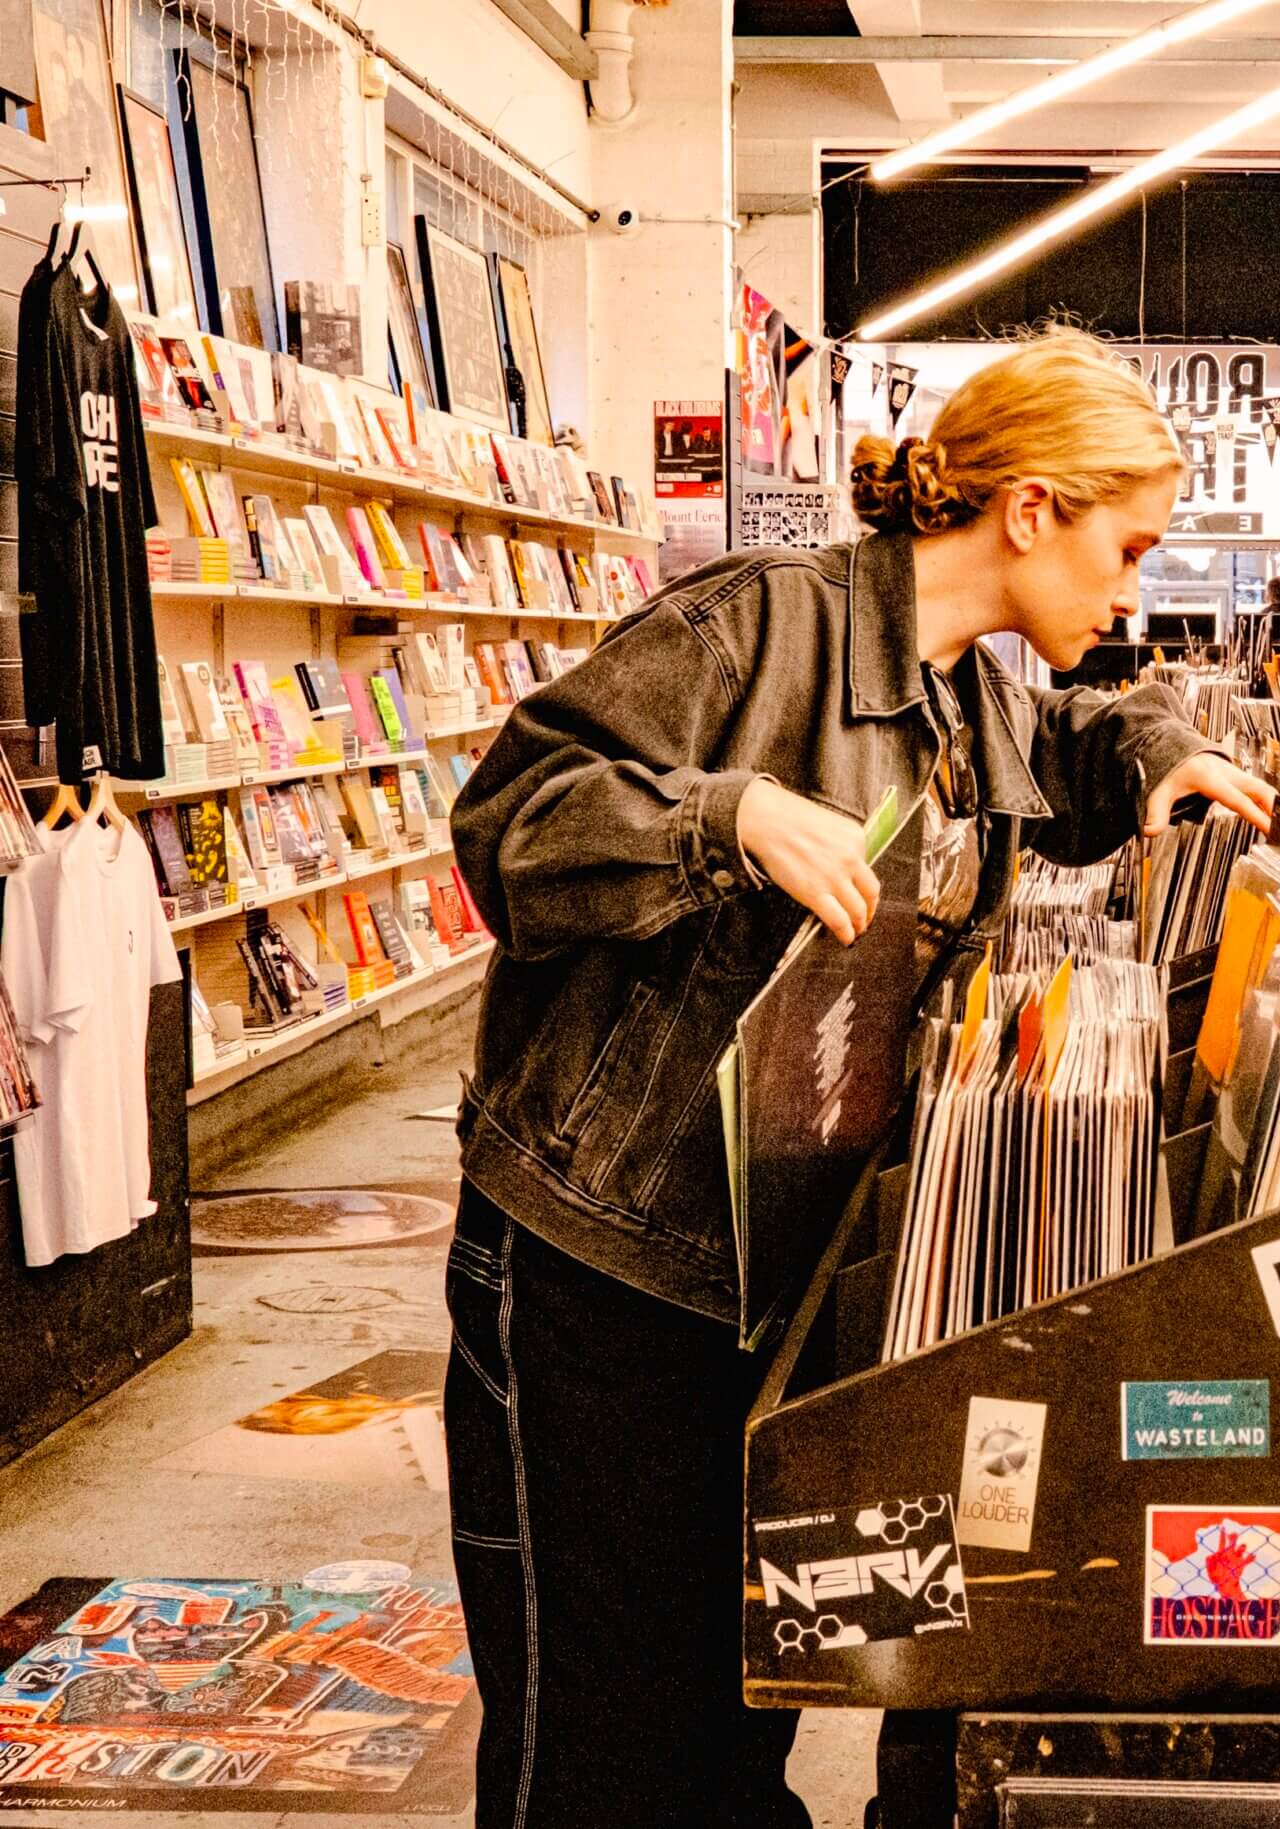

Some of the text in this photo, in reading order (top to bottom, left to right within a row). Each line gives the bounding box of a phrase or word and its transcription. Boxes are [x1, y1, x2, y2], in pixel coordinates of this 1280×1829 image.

[1167, 1389, 1233, 1406] Welcome
[1192, 1411, 1203, 1421] to
[1135, 1428, 1265, 1446] WASTELAND
[980, 1484, 1016, 1505] ONE
[755, 1516, 813, 1532] PRODUCER
[820, 1513, 835, 1523] DJ
[962, 1502, 1030, 1524] LOUDER
[1151, 1596, 1280, 1639] HOSTAGE
